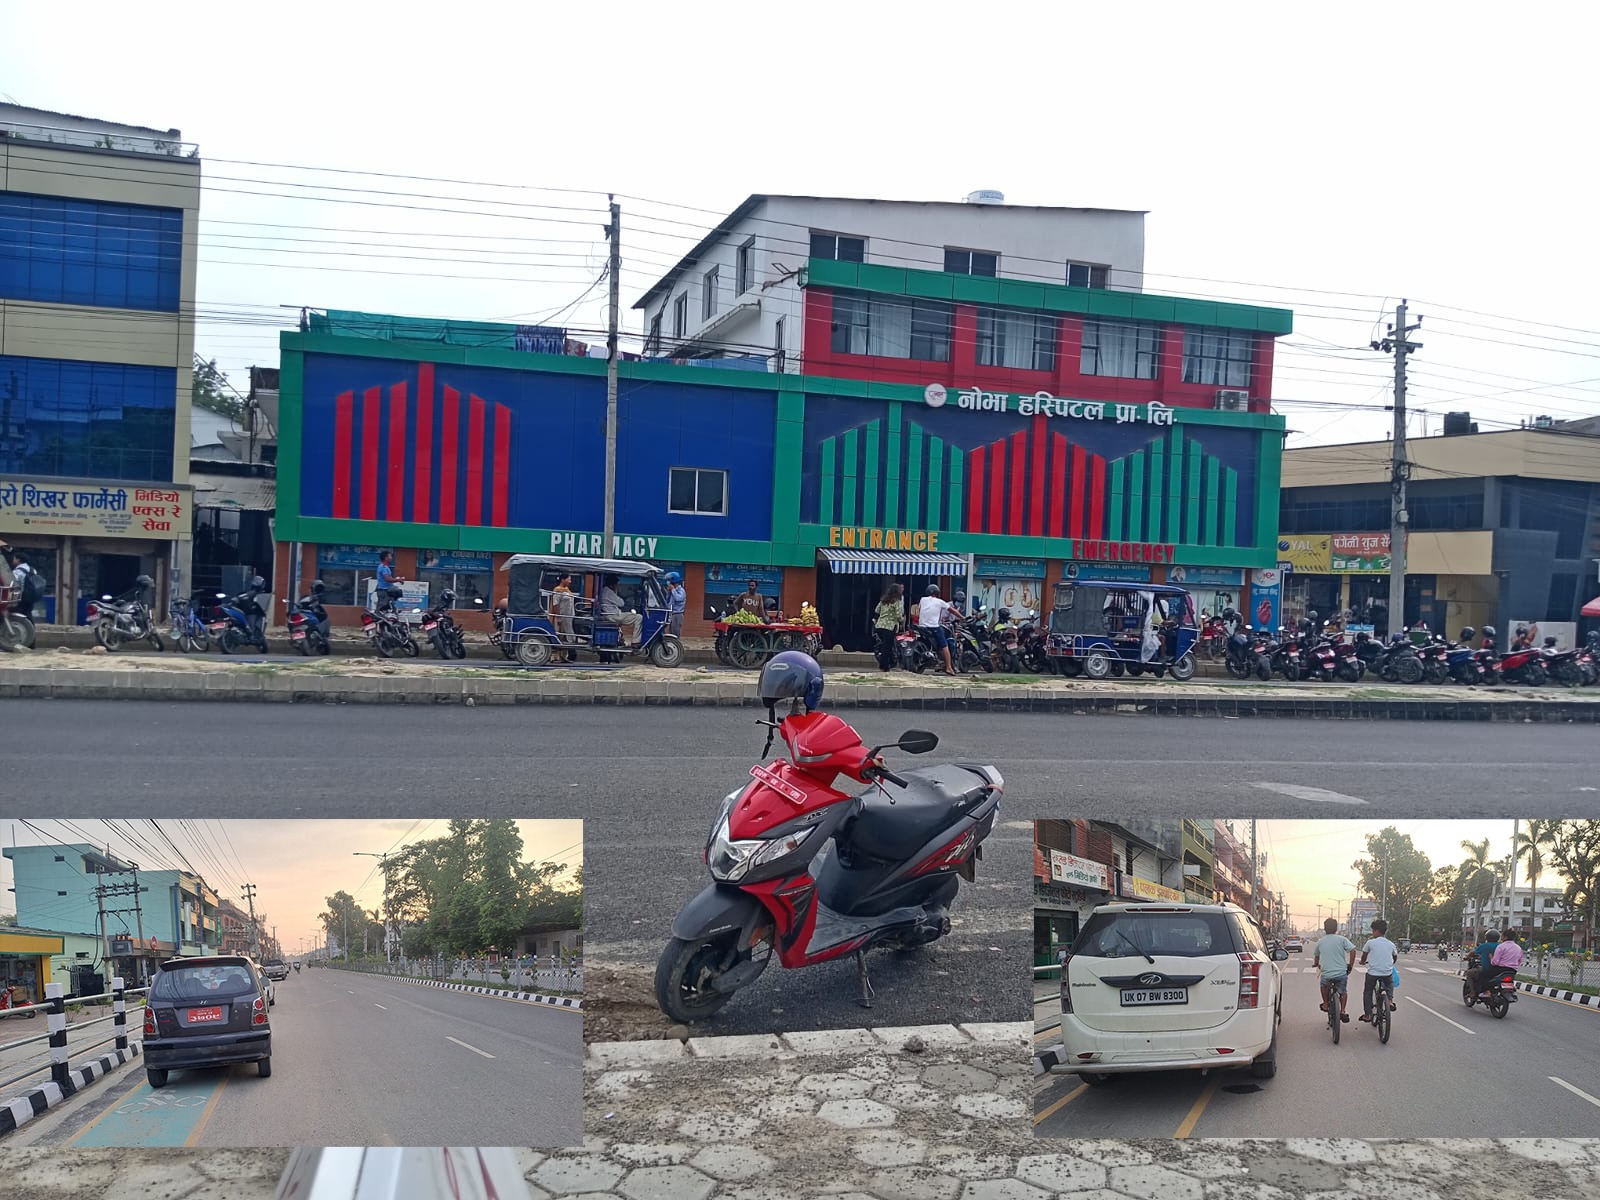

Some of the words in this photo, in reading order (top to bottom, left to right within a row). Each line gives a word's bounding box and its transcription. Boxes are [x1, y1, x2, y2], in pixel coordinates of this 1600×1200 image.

[957, 386, 1009, 413] नोभा
[1018, 390, 1106, 421] हस्पिटल
[22, 483, 69, 509] शिखर
[73, 487, 128, 511] फार्मेसी
[135, 489, 180, 503] भिडियो
[141, 519, 170, 532] सेवा
[829, 527, 939, 552] ENTRANCE
[1072, 540, 1176, 563] EMERGENCY
[1124, 993, 1135, 1002] UK
[1136, 992, 1147, 1002] 07
[1149, 992, 1161, 1001] BW
[1163, 991, 1184, 1000] 8300
